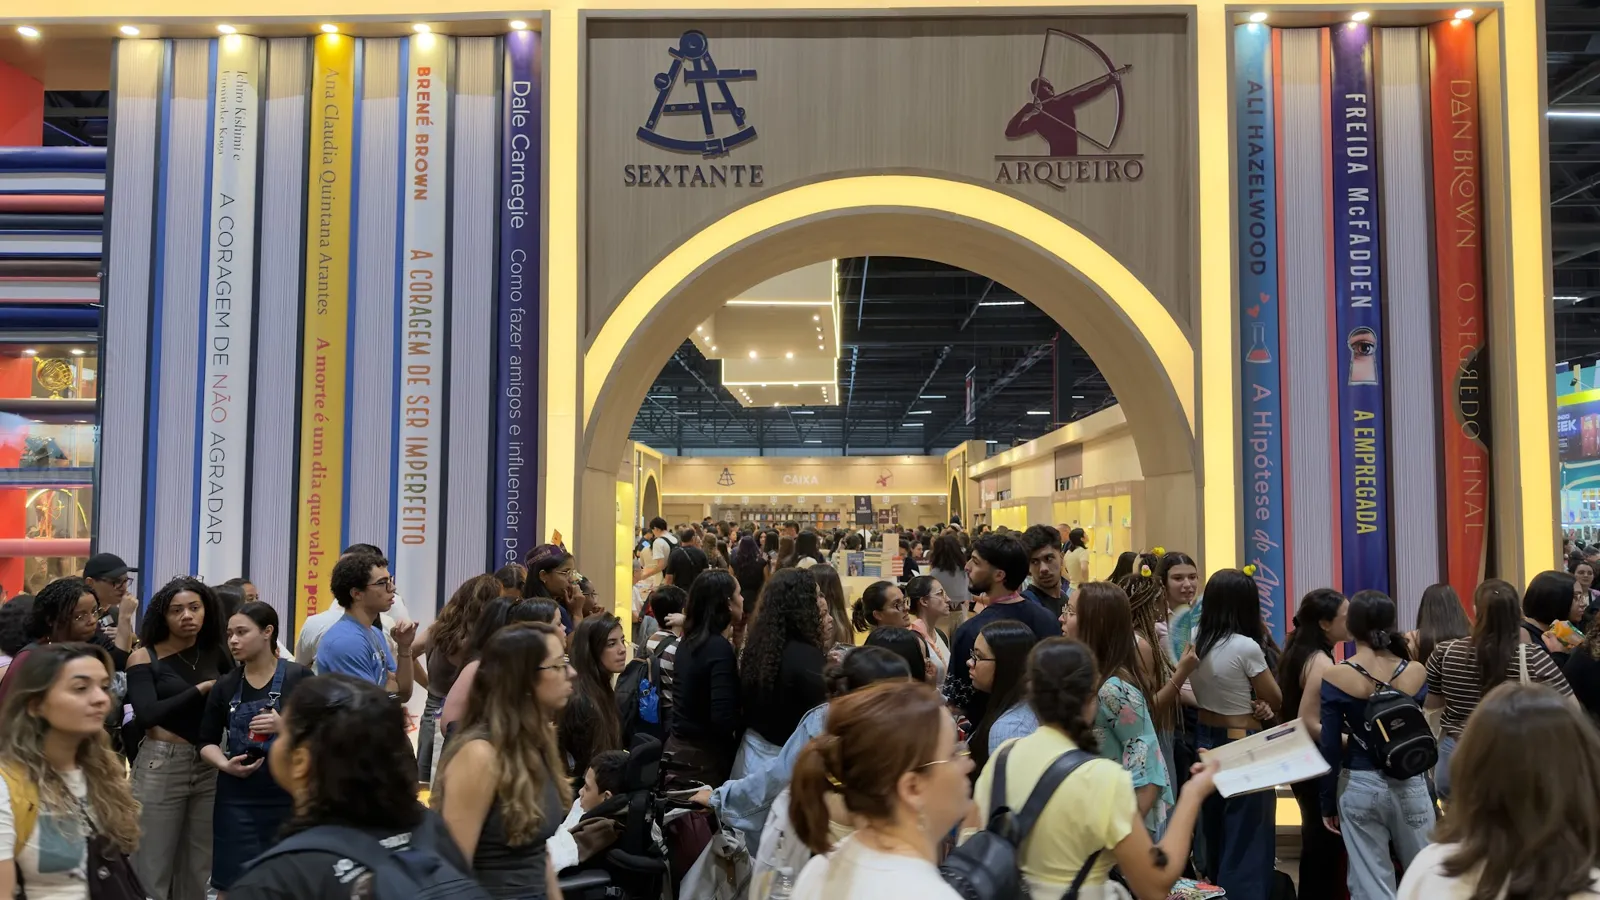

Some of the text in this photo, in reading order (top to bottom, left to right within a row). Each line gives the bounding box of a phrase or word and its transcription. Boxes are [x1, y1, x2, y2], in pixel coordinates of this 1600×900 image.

[233, 70, 249, 161] Ichiro Kishimi e
[413, 66, 434, 201] BRENÉ BROWN
[1345, 93, 1369, 174] FREIDA
[217, 127, 229, 156] Koga
[506, 81, 531, 229] Dale Carnegie
[1450, 80, 1476, 248] DAN BROWN
[317, 67, 340, 316] Ana Claudia Quintana Arantes
[624, 164, 764, 188] SEXTANTE
[994, 159, 1144, 192] ARQUEIRO
[1246, 80, 1266, 276] ALI HAZELWOOD
[509, 249, 527, 302] Como
[1456, 282, 1476, 302] O
[316, 337, 330, 351] A
[509, 307, 526, 350] fazer
[206, 193, 235, 545] A CORAGEM DE NÃO AGRADAR
[314, 355, 327, 409] morte
[506, 355, 525, 419] amigos
[1252, 383, 1272, 402] A
[313, 412, 330, 423] é
[402, 249, 433, 545] A CORAGEM DE SER IMPERFEITO
[312, 426, 324, 457] um
[508, 424, 521, 436] e
[311, 461, 327, 489] dia
[506, 442, 525, 533] influenciar
[783, 474, 819, 485] CAIXA
[1250, 411, 1273, 521] Hipótese
[1353, 410, 1378, 535] A EMPREGADA
[307, 493, 321, 526] que
[1461, 455, 1484, 535] FINAL
[308, 531, 324, 567] vale
[1252, 529, 1279, 553] do
[308, 570, 319, 580] a
